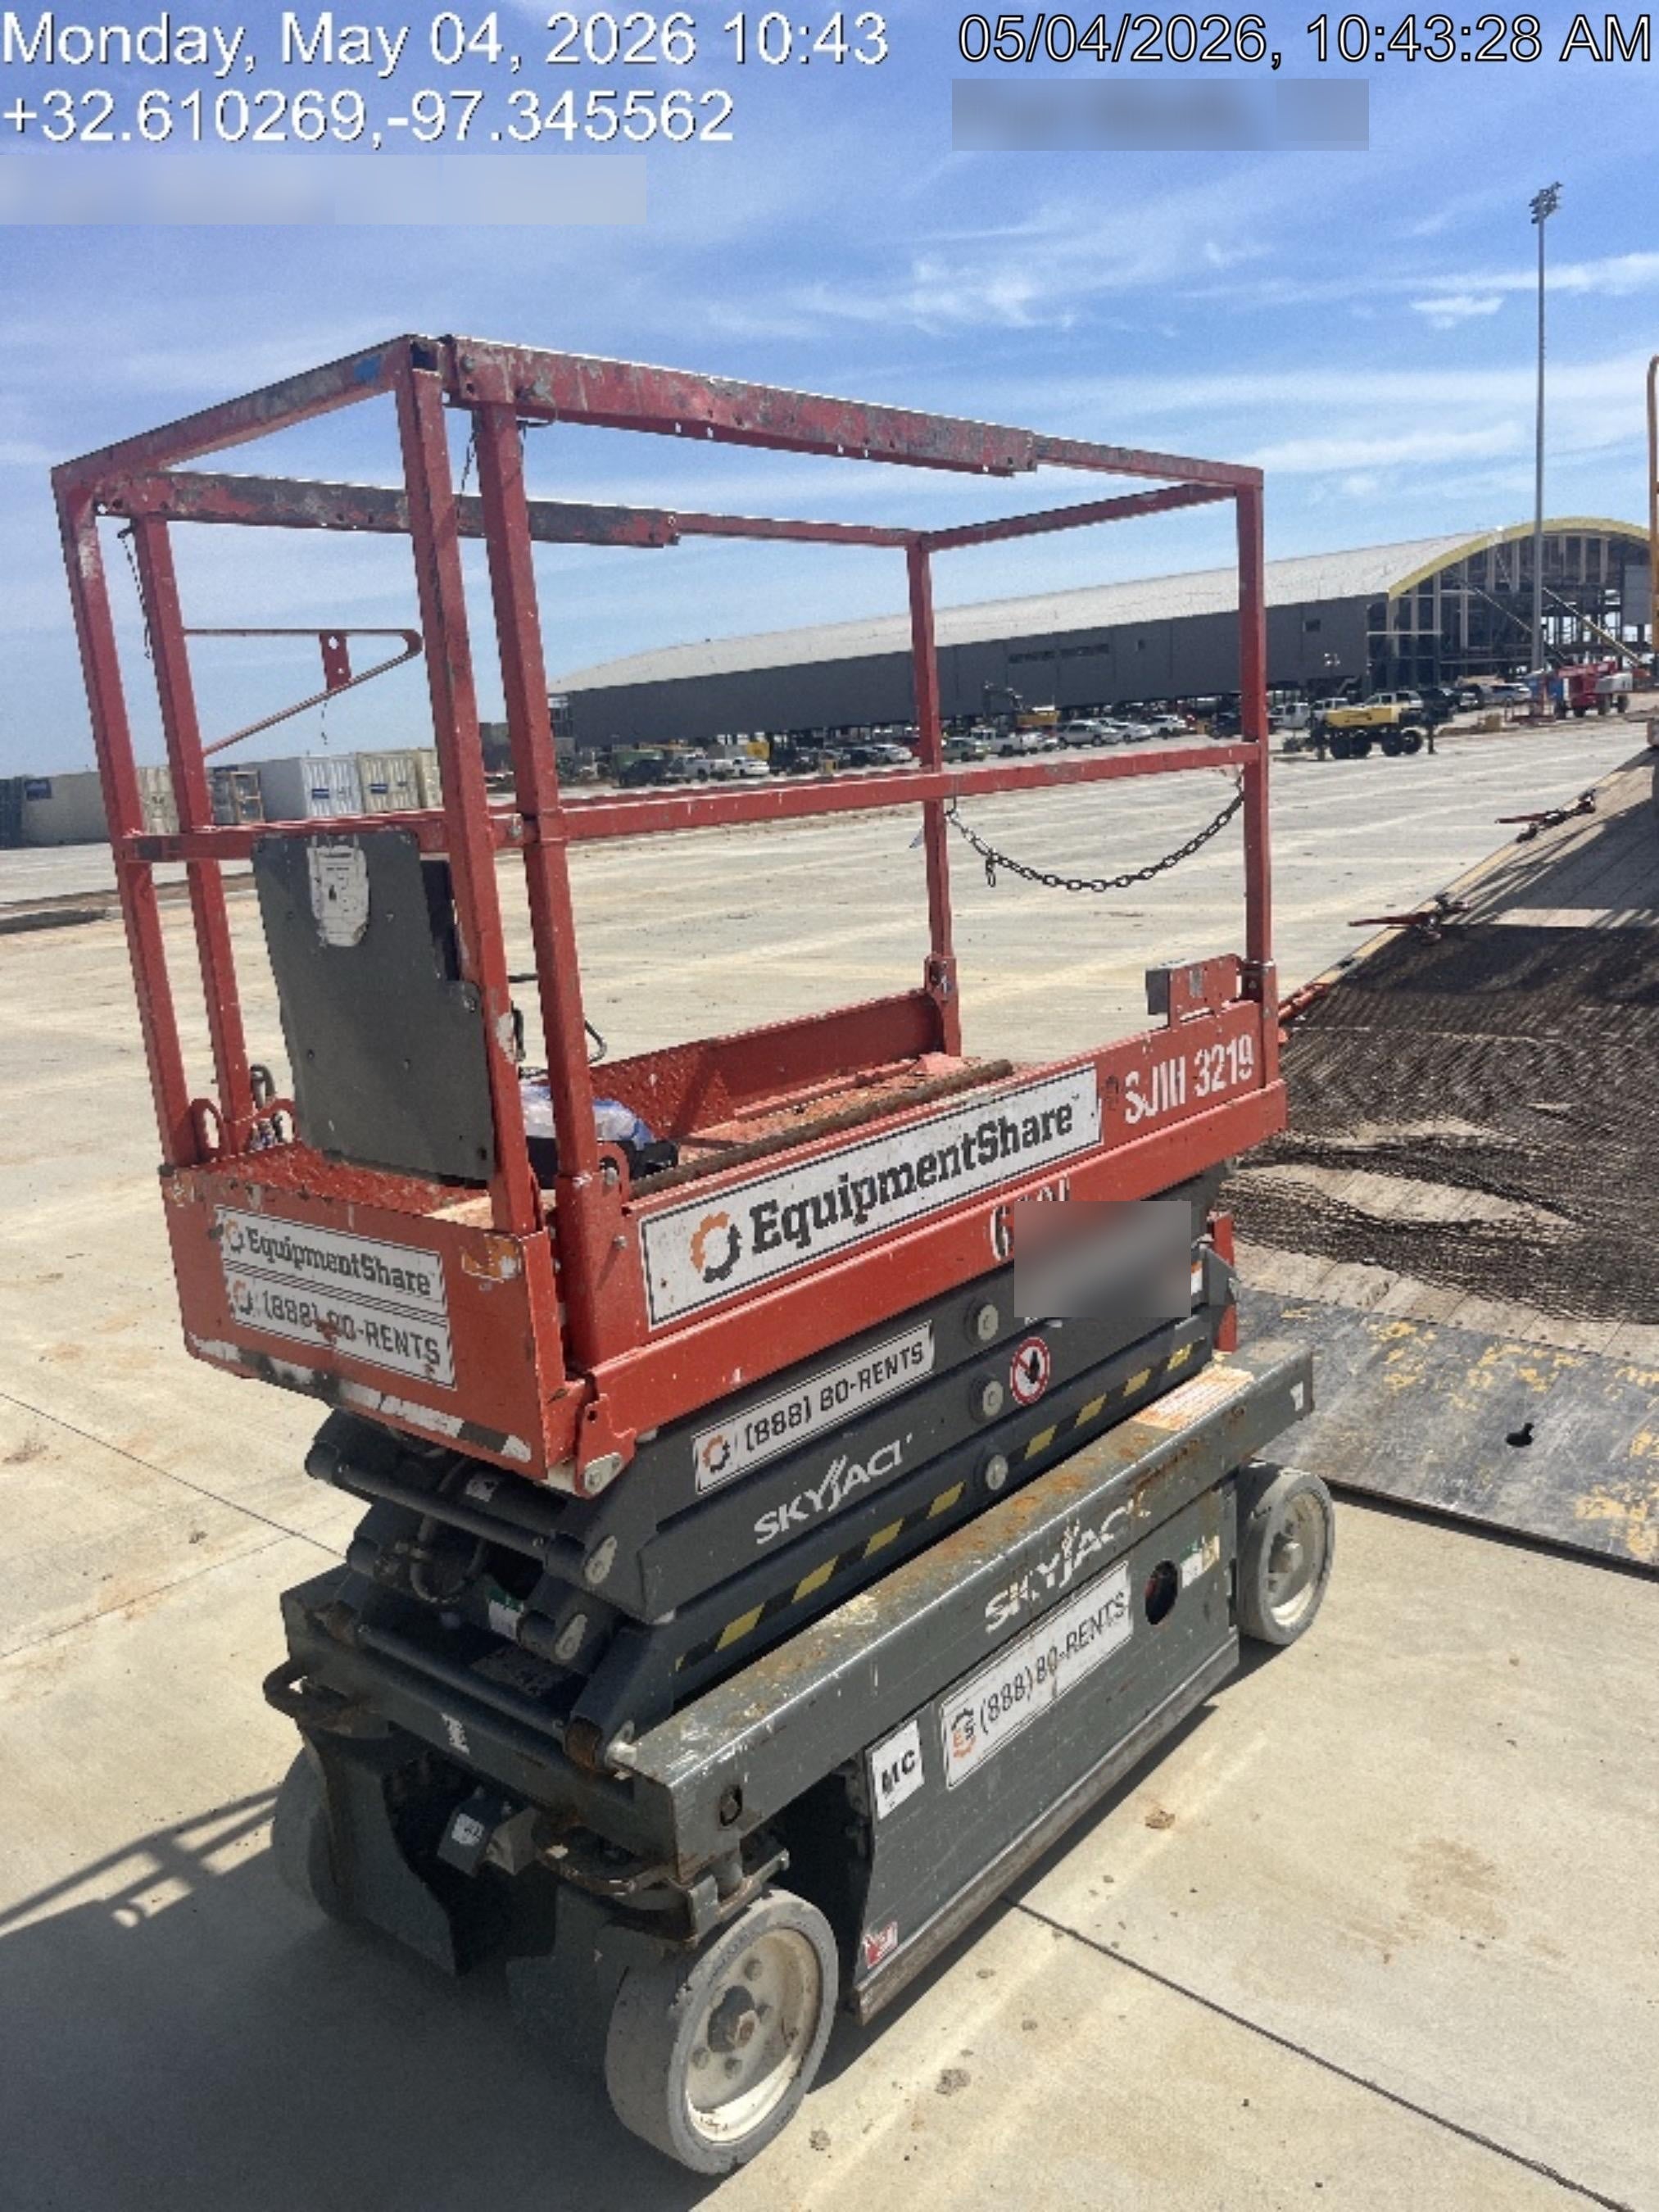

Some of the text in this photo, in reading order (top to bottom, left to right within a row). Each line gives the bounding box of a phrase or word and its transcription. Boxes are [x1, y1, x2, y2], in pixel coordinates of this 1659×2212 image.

[1194, 1034, 1254, 1097] 3219
[749, 1103, 1073, 1255] EquipmentShare
[246, 1226, 431, 1295] EquipmentShare
[745, 1395, 813, 1451] (888)
[980, 1664, 1034, 1735] (888)
